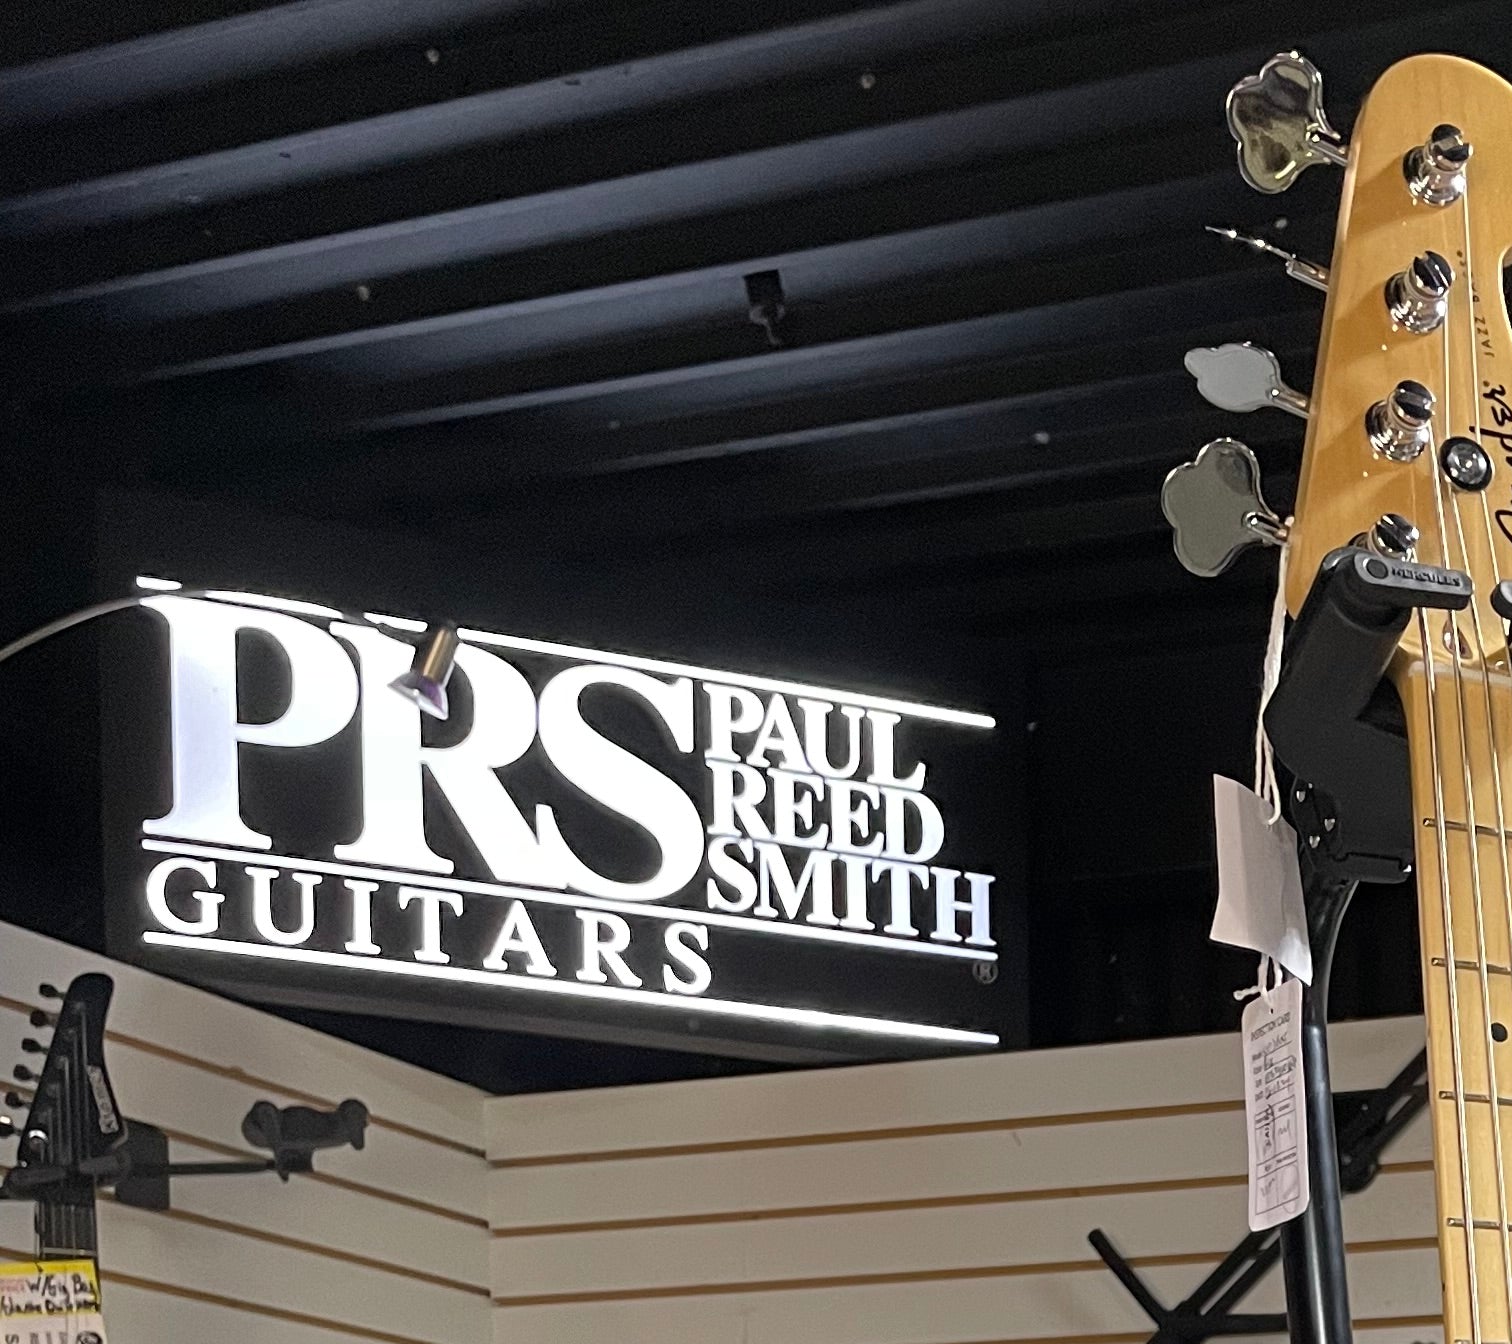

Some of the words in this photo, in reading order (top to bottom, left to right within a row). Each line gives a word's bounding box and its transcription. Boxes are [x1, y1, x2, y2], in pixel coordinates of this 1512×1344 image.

[1474, 316, 1496, 358] JAZZ
[137, 592, 705, 903] PRS
[702, 680, 928, 790] PAUL
[706, 757, 948, 864] REED
[144, 857, 714, 997] GUITARS
[706, 835, 998, 948] SMITH
